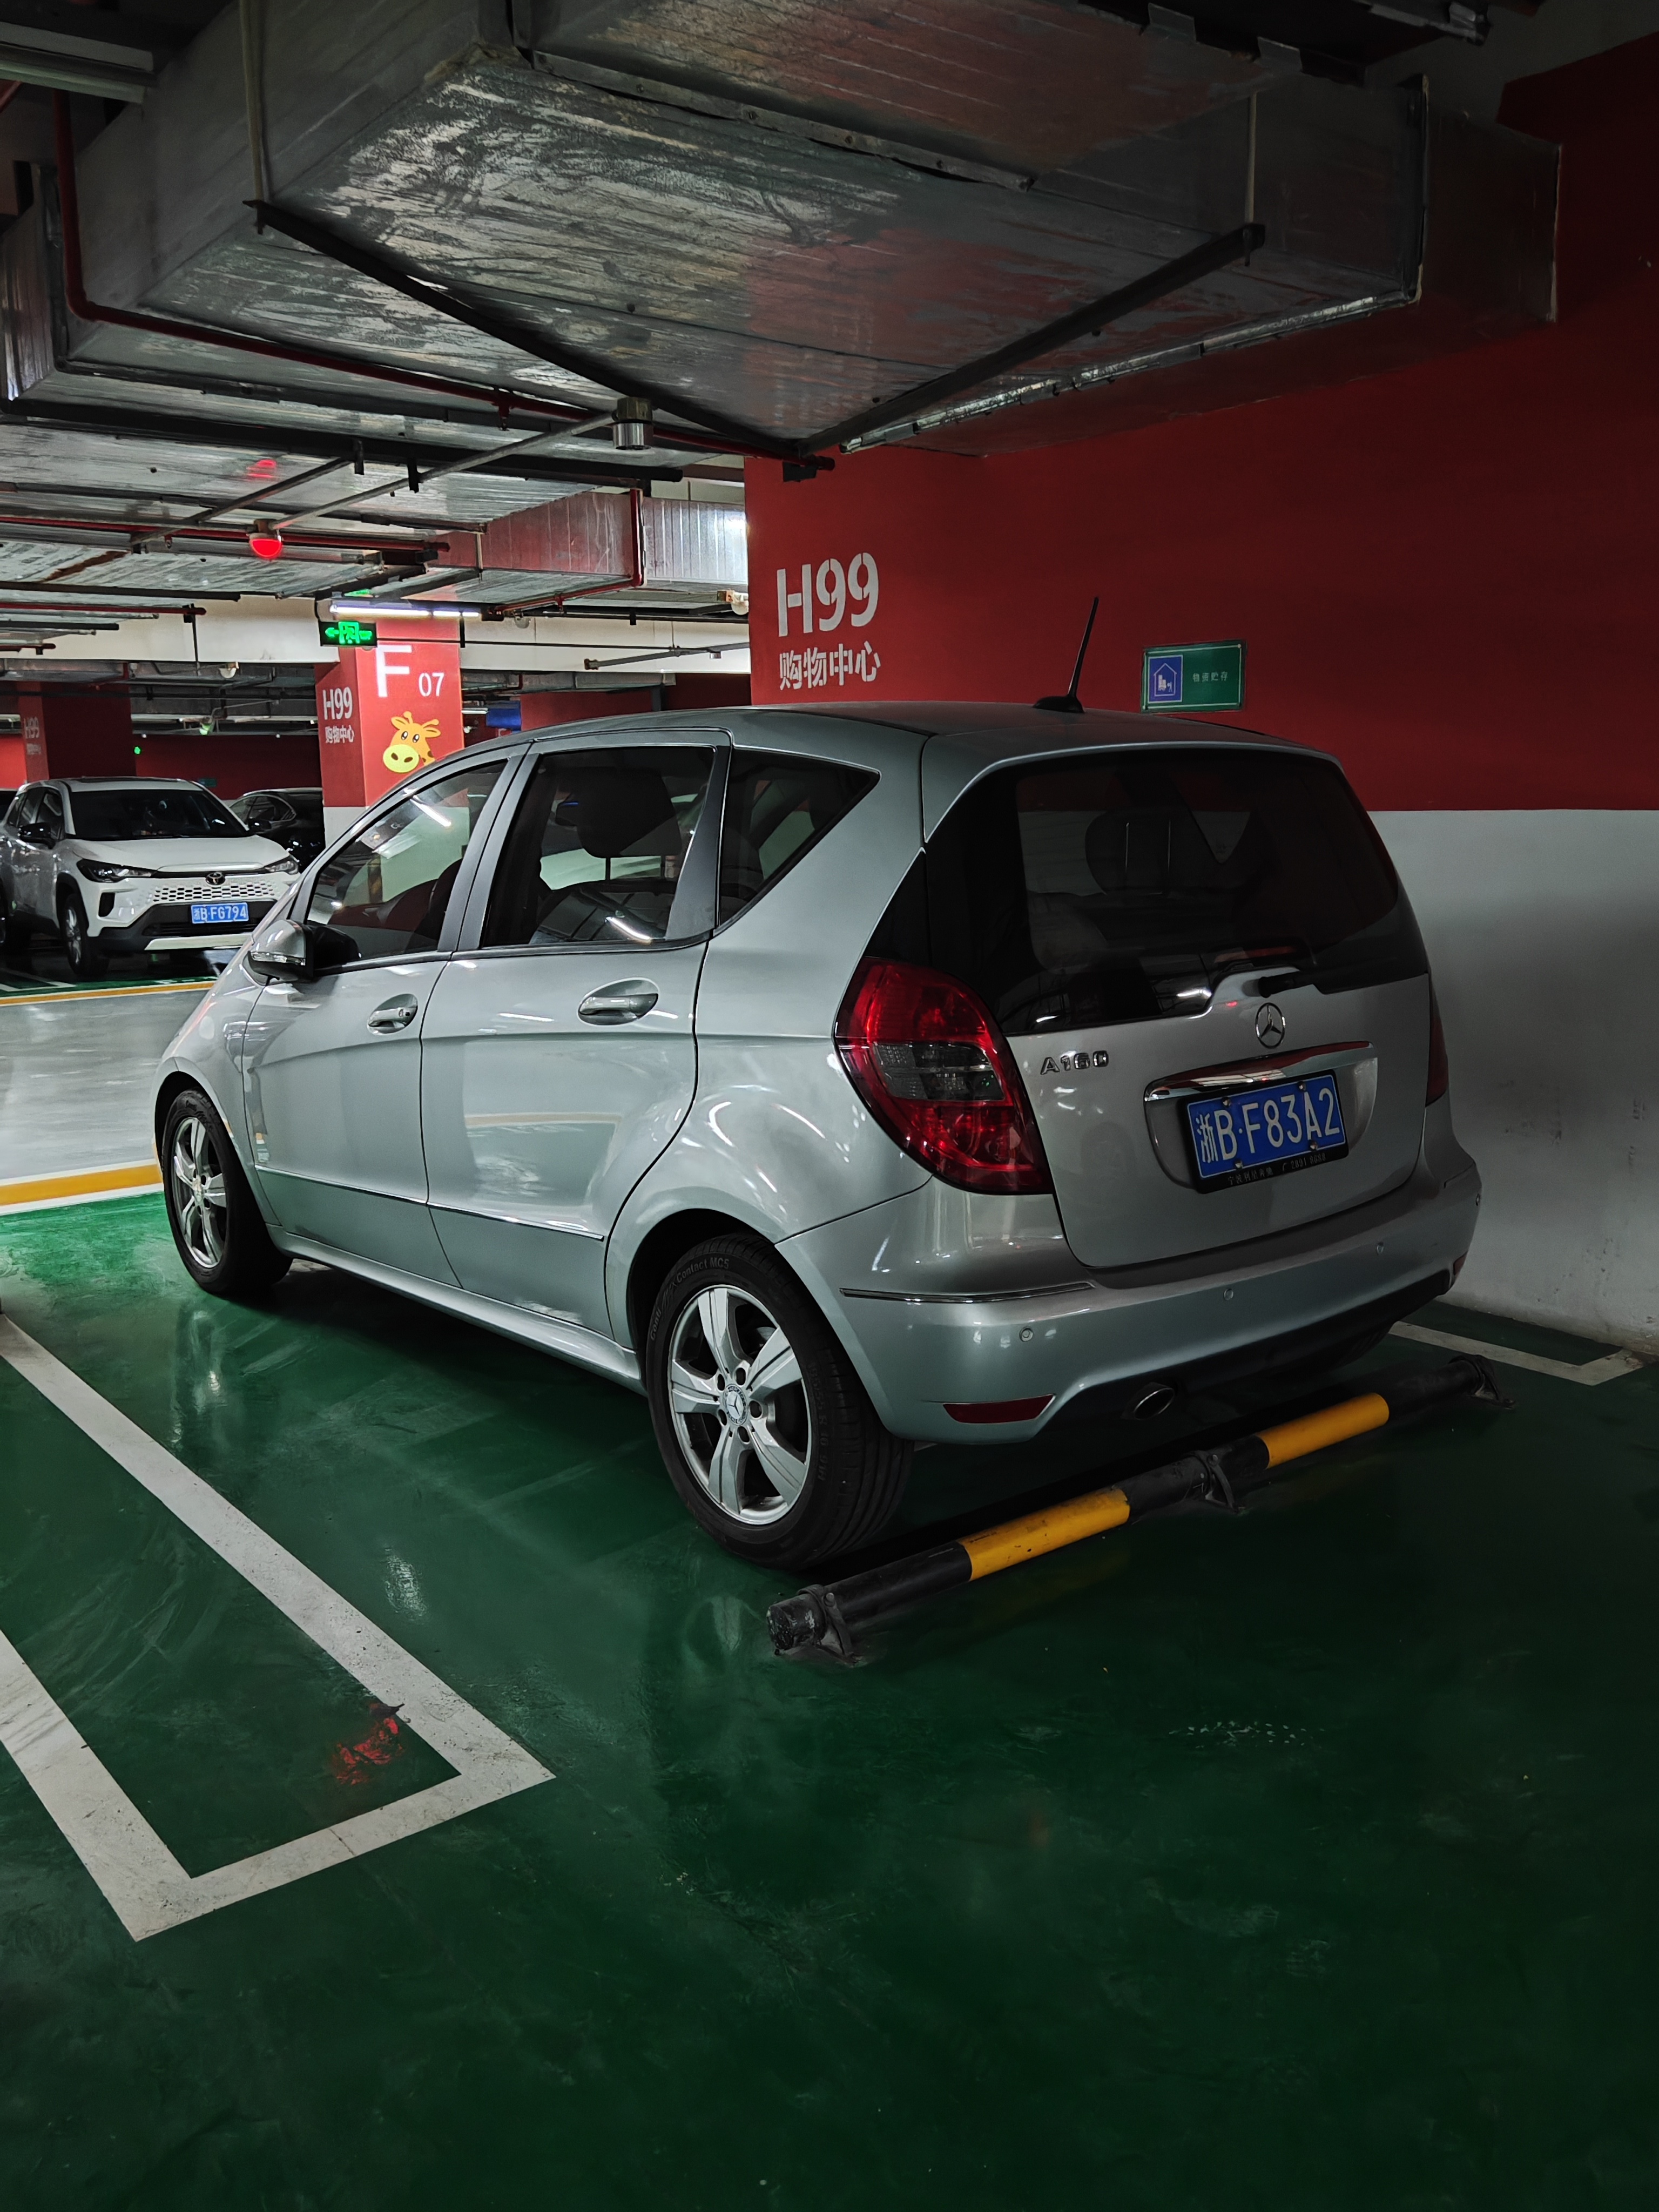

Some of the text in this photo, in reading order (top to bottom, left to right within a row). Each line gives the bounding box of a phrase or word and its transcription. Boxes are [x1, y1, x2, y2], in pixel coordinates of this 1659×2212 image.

[777, 552, 879, 637] H99
[375, 644, 445, 697] F 07
[779, 640, 881, 691] 购物中心
[322, 686, 353, 720] H99
[325, 724, 355, 744] 购物中心
[1040, 1050, 1109, 1075] A160
[710, 1257, 730, 1270] MC5
